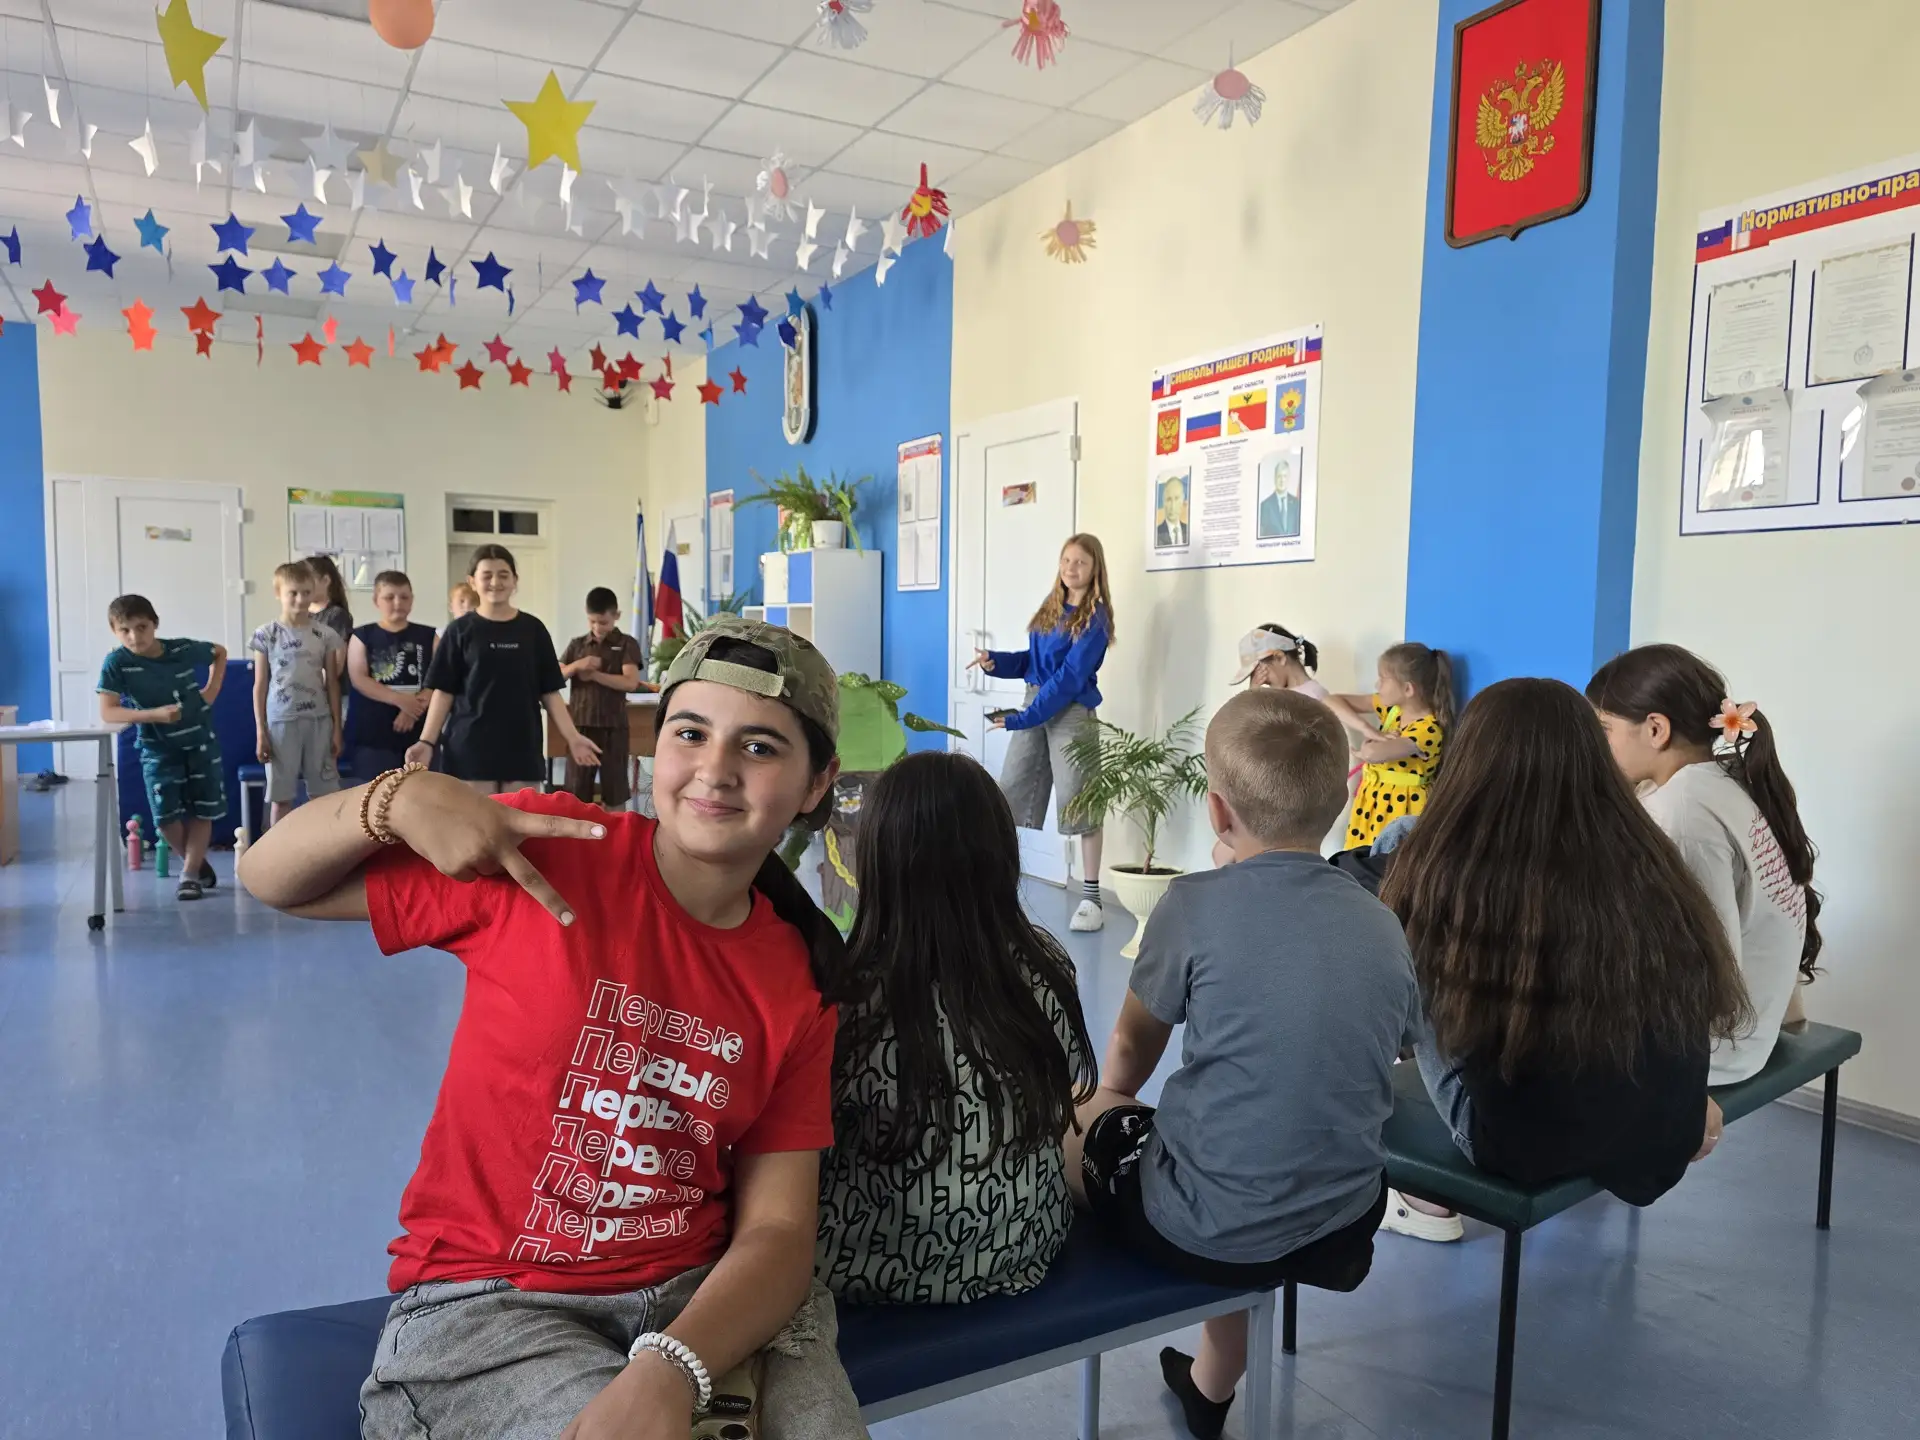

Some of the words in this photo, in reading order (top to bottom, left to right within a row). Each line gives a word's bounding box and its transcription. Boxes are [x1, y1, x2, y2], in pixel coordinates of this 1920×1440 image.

[1741, 170, 1920, 232] Нормативно-пра
[1170, 362, 1214, 385] СИМВОЛЫ
[1252, 341, 1297, 364] РОДИНЫ
[587, 978, 744, 1064] Первые
[571, 1025, 731, 1110] Первые
[558, 1070, 715, 1146] Первые
